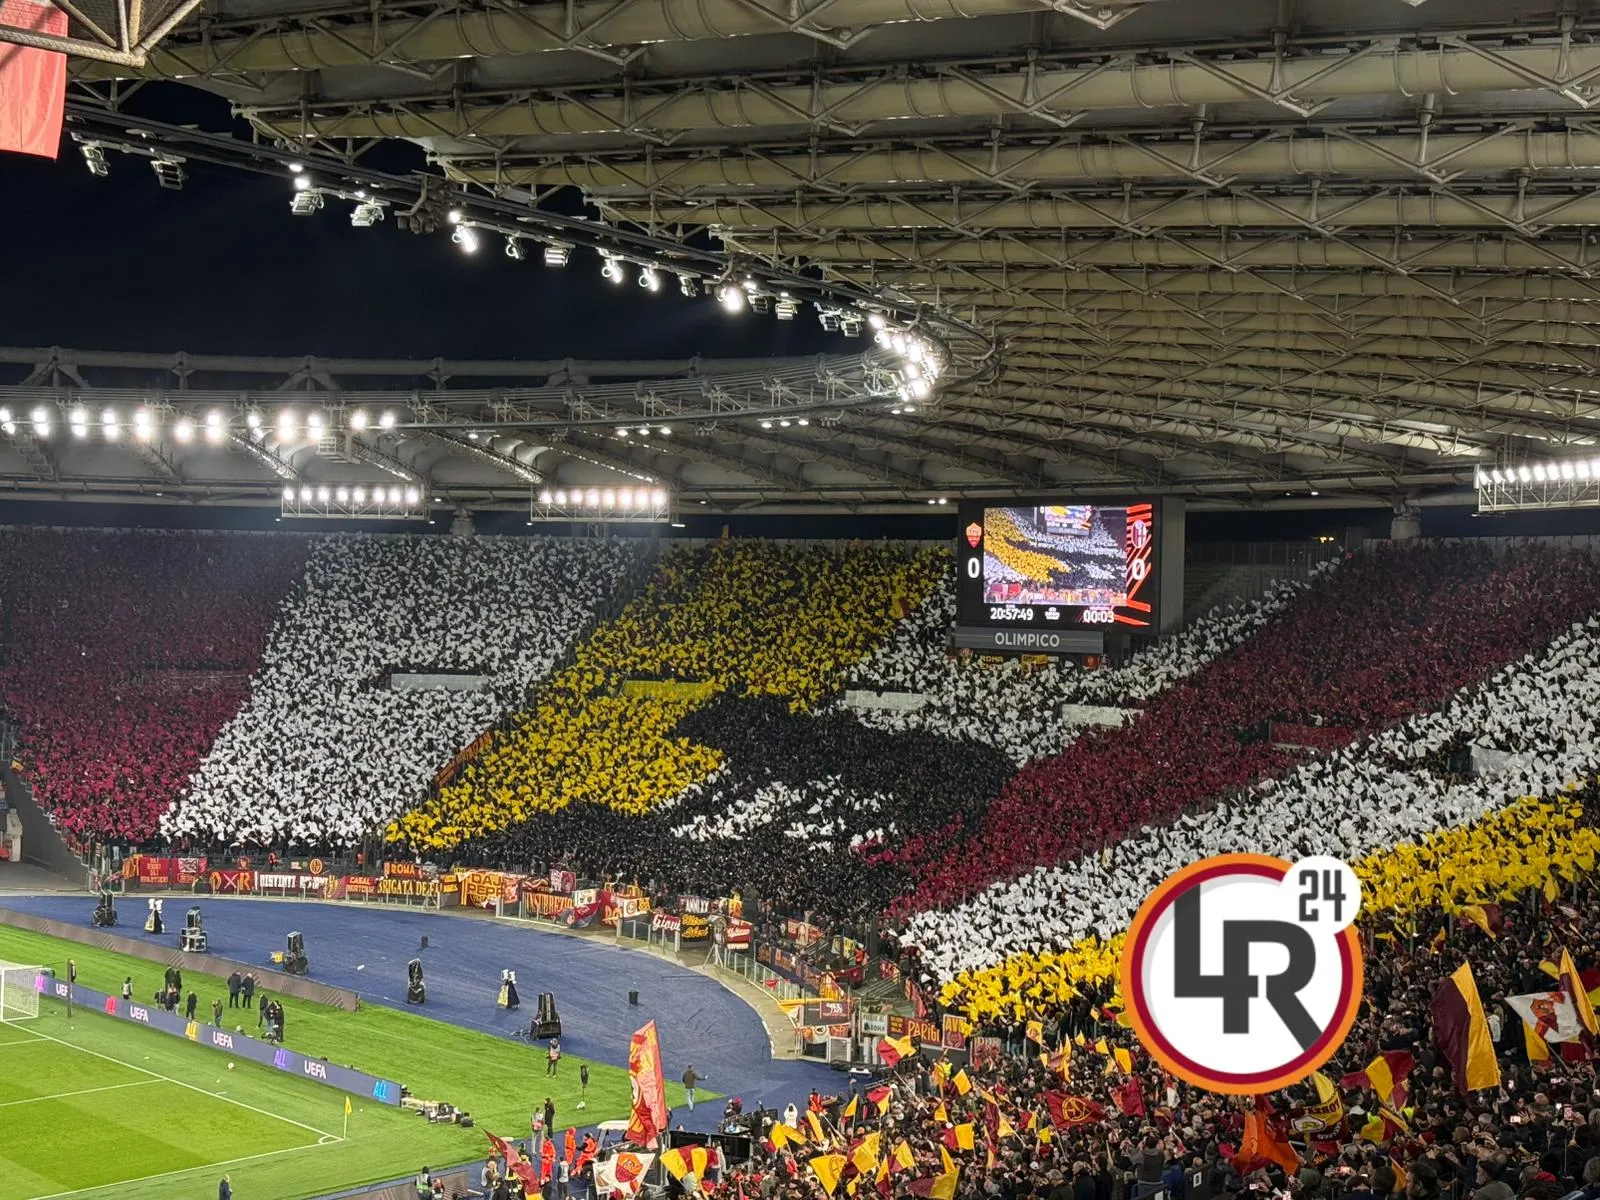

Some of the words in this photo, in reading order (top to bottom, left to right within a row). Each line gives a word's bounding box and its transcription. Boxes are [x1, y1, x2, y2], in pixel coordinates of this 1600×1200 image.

[967, 557, 980, 578] 0
[1132, 559, 1145, 580] 0
[990, 607, 1034, 621] 20:57:49
[1083, 610, 1114, 624] 00:03
[994, 632, 1060, 647] OLIMPICO
[391, 863, 416, 876] ROMA
[130, 1005, 149, 1023] UEFA
[212, 1031, 233, 1049] UEFA
[274, 1050, 287, 1066] ALL
[304, 1061, 326, 1079] UEFA
[373, 1081, 388, 1098] ALL
